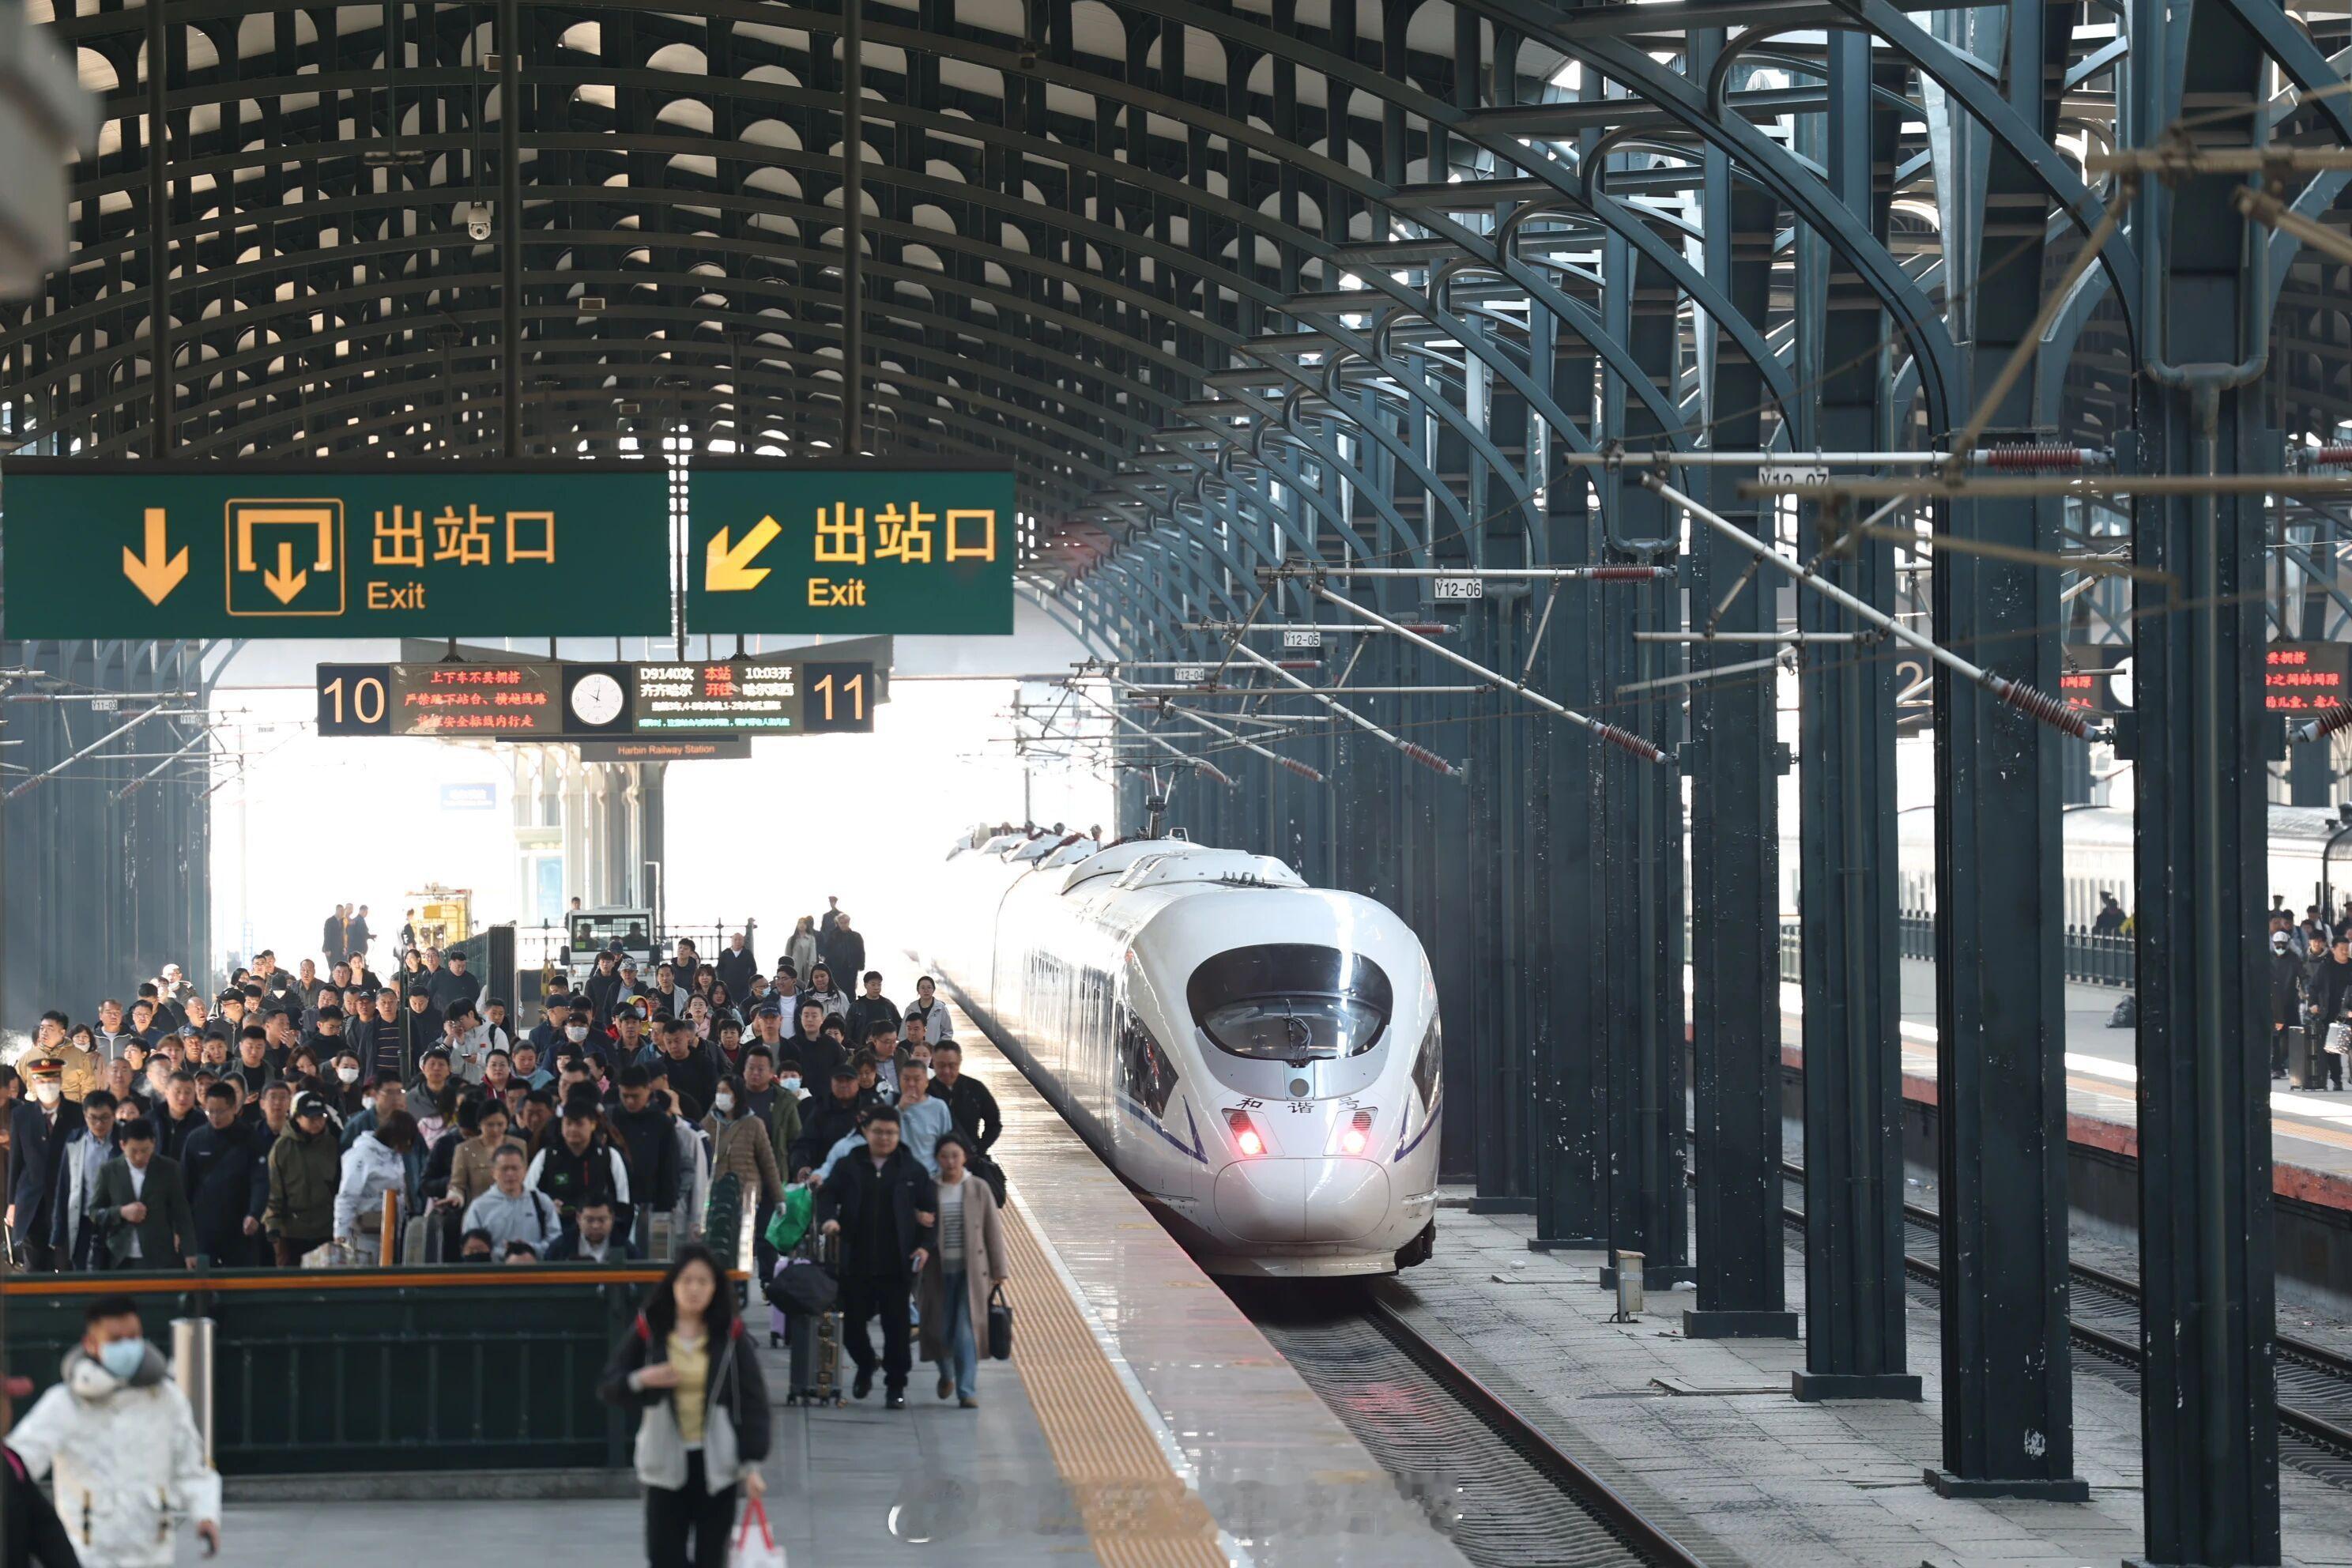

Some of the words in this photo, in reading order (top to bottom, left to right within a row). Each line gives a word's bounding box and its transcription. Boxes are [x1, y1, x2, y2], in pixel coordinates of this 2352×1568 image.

[374, 504, 555, 567] 出站口
[815, 501, 995, 565] 出站口
[368, 582, 425, 609] Exit
[808, 578, 866, 606] Exit
[1436, 582, 1481, 597] Y12-06
[1285, 635, 1320, 646] Y12-05
[431, 671, 522, 684] 上下车不要拥挤
[704, 667, 732, 680] 本站
[744, 667, 793, 680] 10:03开
[1175, 670, 1203, 680] Y12-04
[705, 682, 733, 696] 开往
[814, 673, 863, 720] 11
[324, 677, 385, 723] 10
[618, 745, 646, 756] Harbin
[649, 744, 683, 756] Railway
[684, 744, 714, 754] Station
[1236, 1097, 1360, 1114] 和谐号
